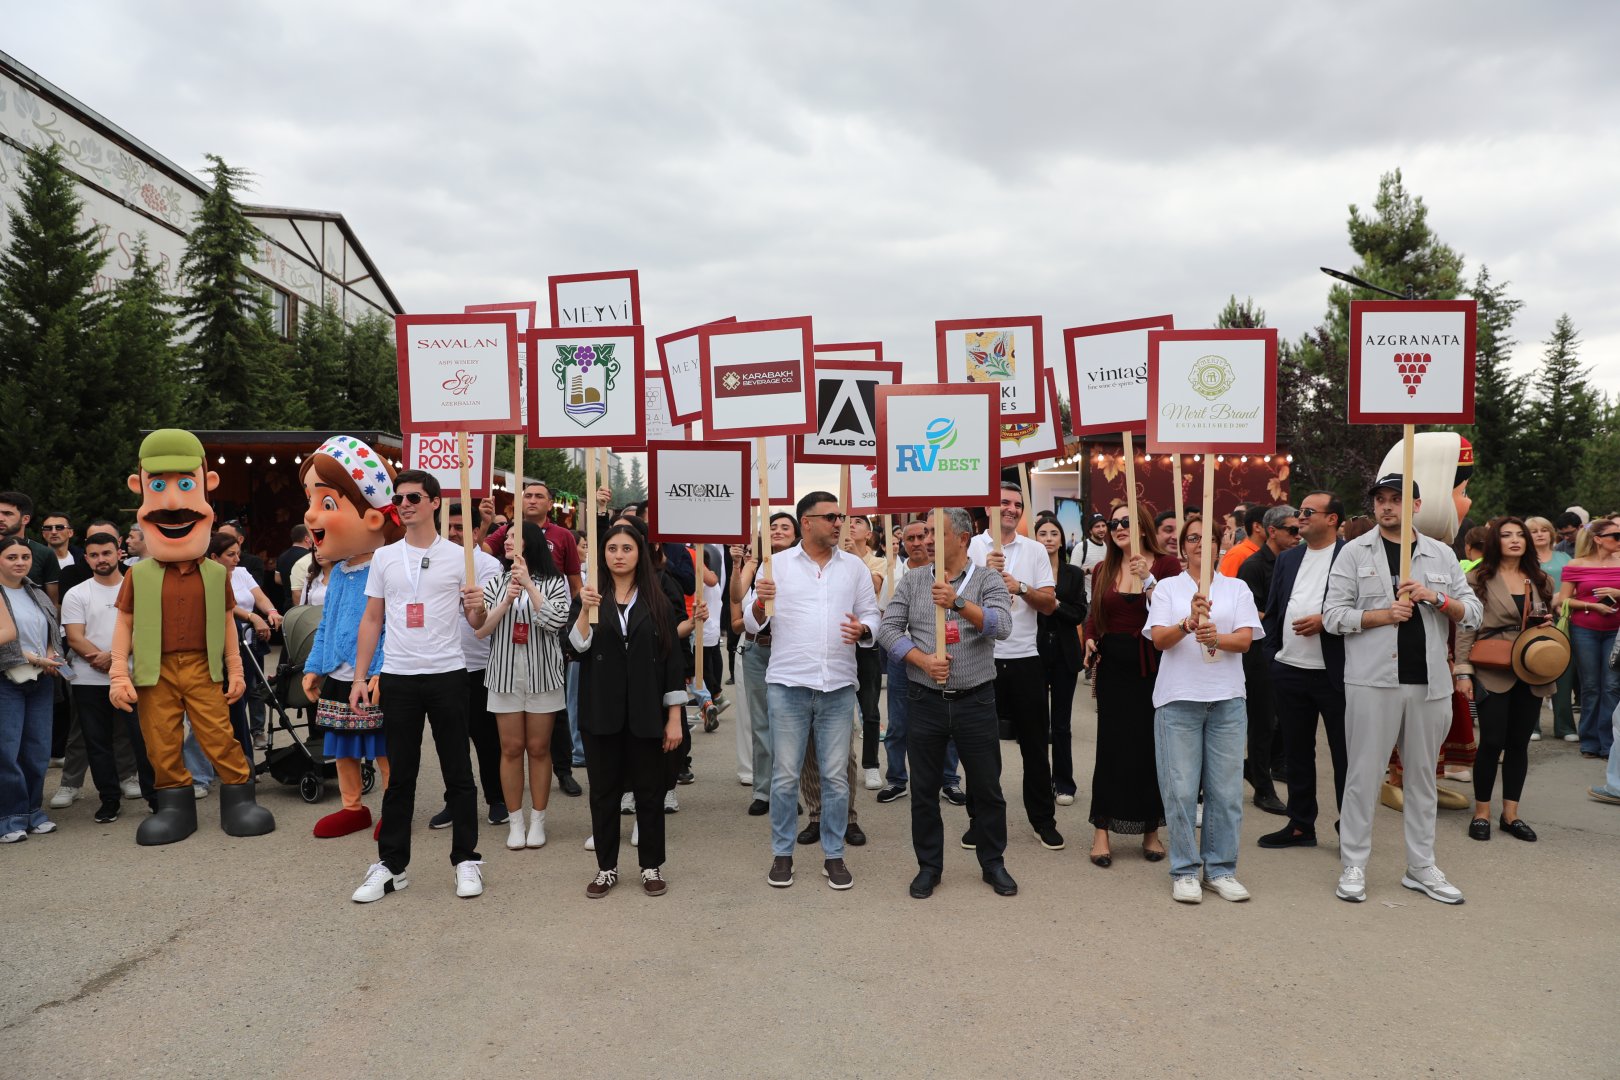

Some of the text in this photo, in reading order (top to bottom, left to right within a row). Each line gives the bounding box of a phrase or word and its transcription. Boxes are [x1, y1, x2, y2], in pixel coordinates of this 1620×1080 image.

[417, 338, 498, 349] SAVALAN
[1366, 335, 1460, 345] AZGRANATA
[742, 370, 794, 380] KARABAKH
[743, 378, 780, 386] BEVERAGE
[1162, 403, 1260, 420] Merit Brand
[818, 438, 856, 447] APLUS
